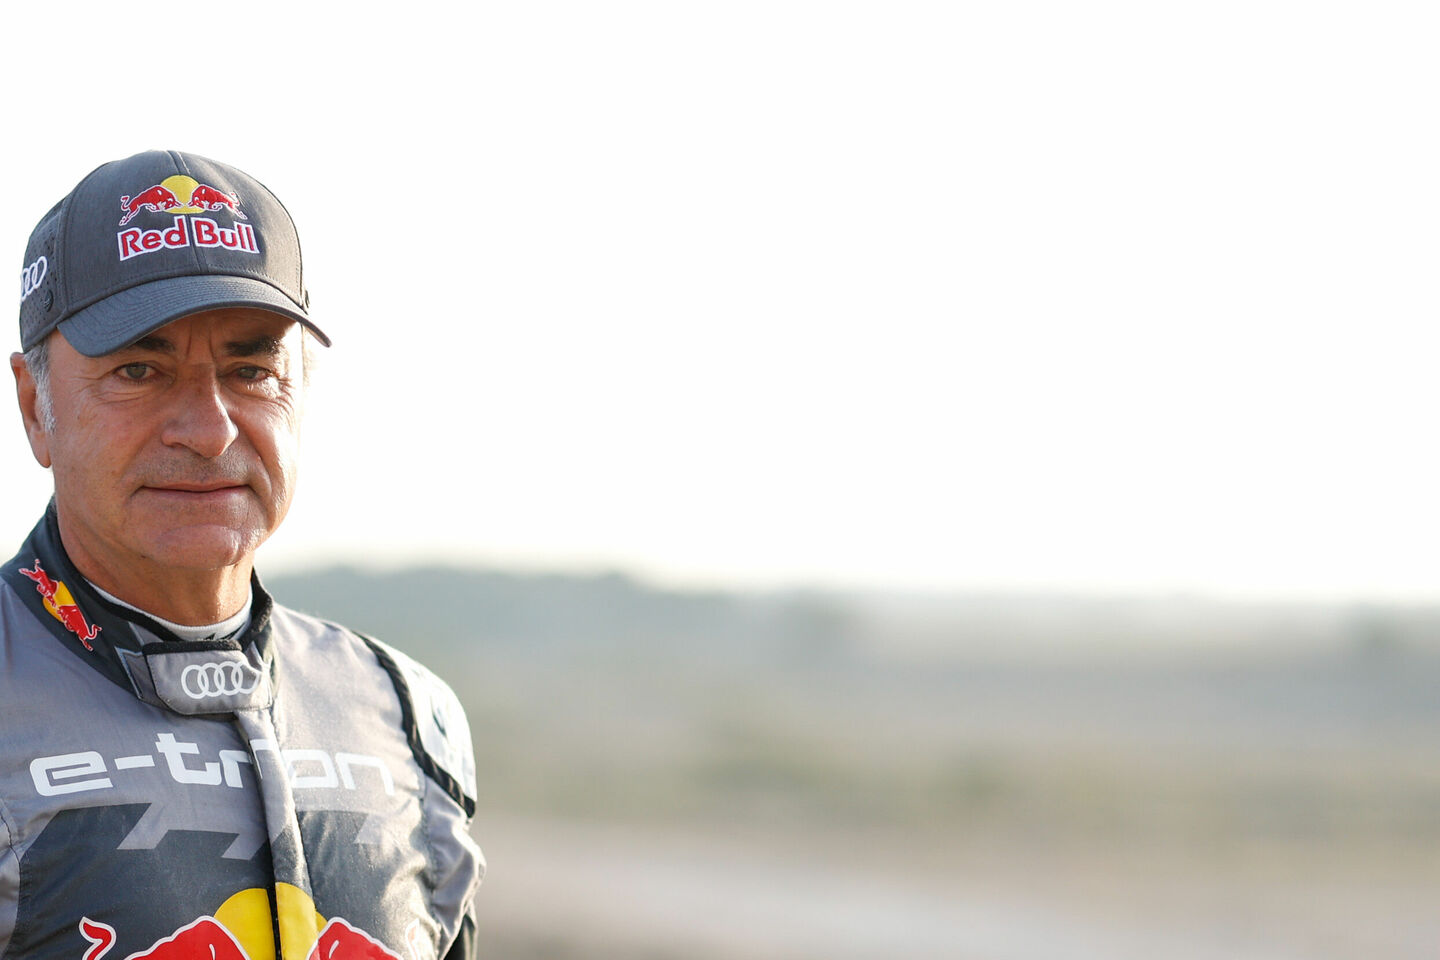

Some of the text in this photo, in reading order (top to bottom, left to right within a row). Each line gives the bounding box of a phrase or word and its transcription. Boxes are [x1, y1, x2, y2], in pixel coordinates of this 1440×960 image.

[117, 215, 259, 261] Red Bull
[30, 733, 394, 797] e-tron
